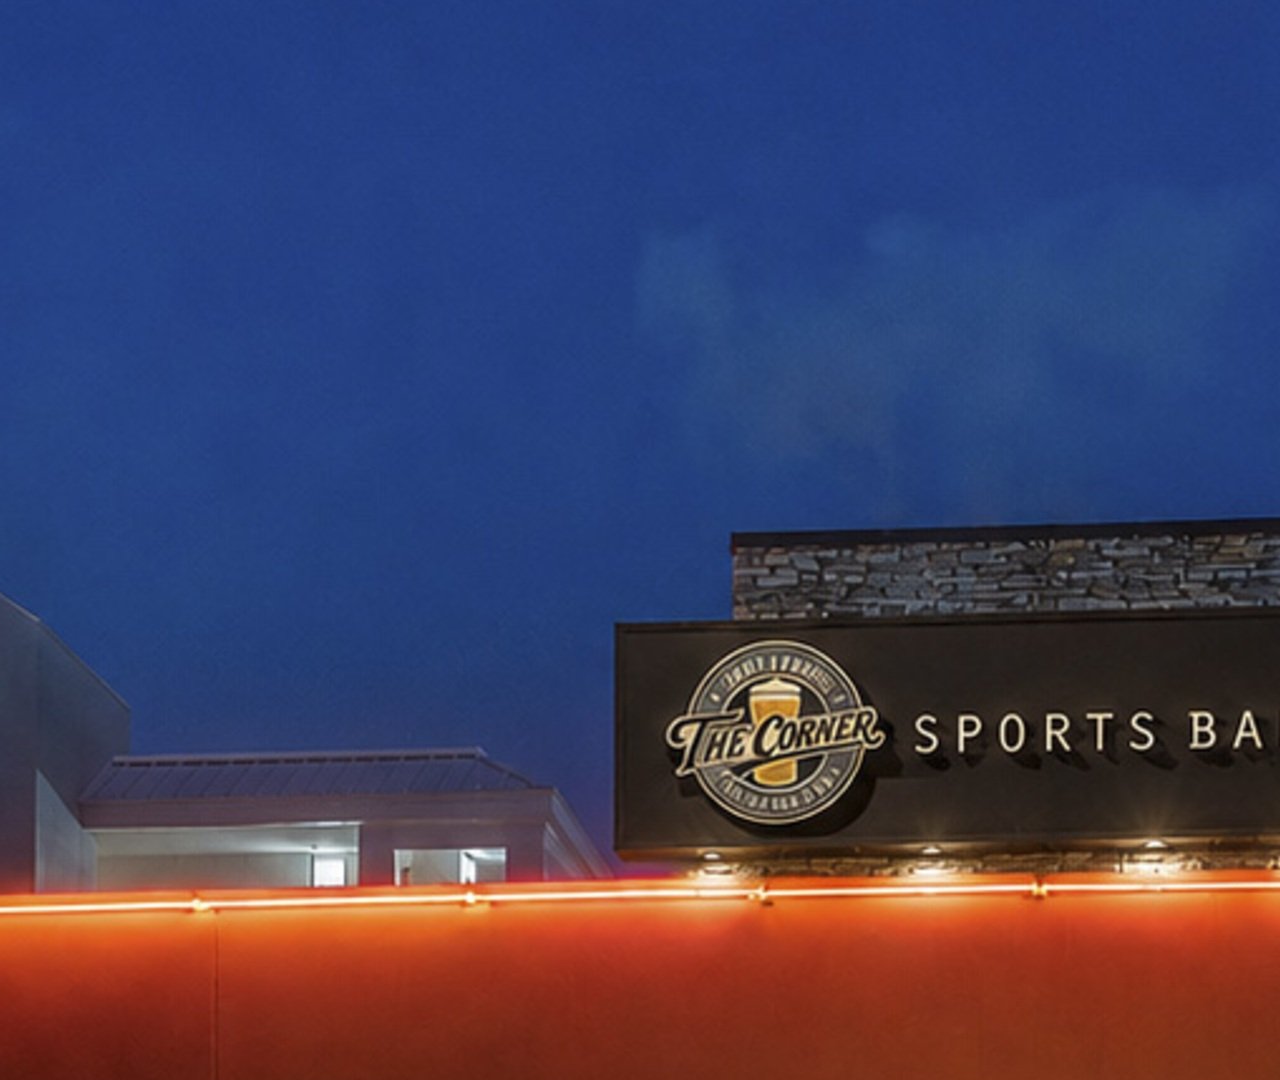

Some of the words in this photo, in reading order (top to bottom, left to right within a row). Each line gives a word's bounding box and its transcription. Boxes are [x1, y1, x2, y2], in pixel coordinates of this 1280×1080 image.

[666, 708, 750, 776] THE
[751, 706, 886, 760] CORNER
[914, 711, 1156, 754] SPORTS
